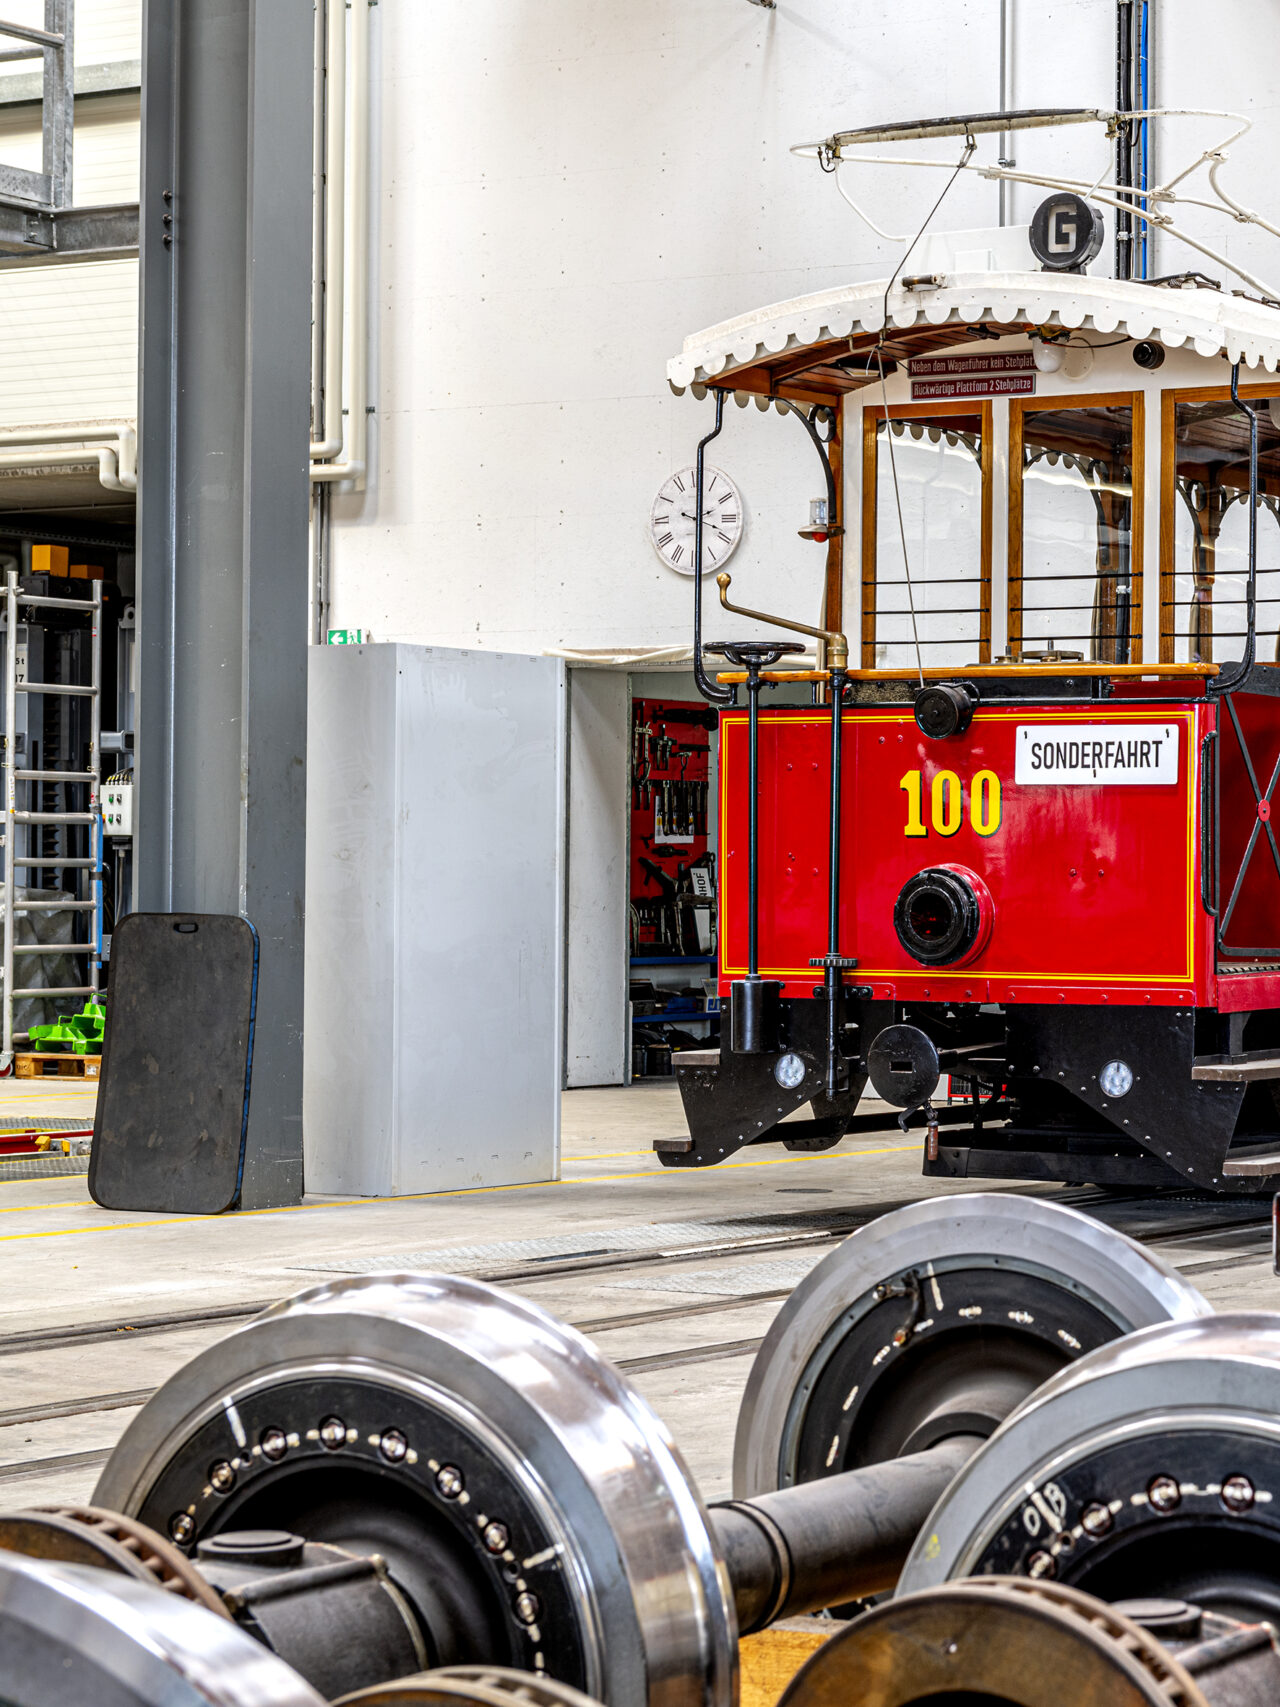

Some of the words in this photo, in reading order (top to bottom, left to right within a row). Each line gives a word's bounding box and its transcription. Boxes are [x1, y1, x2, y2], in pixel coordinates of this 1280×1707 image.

[1048, 203, 1077, 254] G
[911, 360, 932, 373] Neben
[933, 360, 946, 372] dem
[990, 356, 1004, 369] kein
[1005, 354, 1036, 369] Stehplat
[914, 383, 955, 396] Rückwärtige
[956, 380, 988, 393] Plattform
[990, 380, 994, 391] 2
[995, 377, 1031, 392] Stehplätze
[1031, 740, 1163, 770] SONDERFAHRT
[900, 769, 1002, 838] 100
